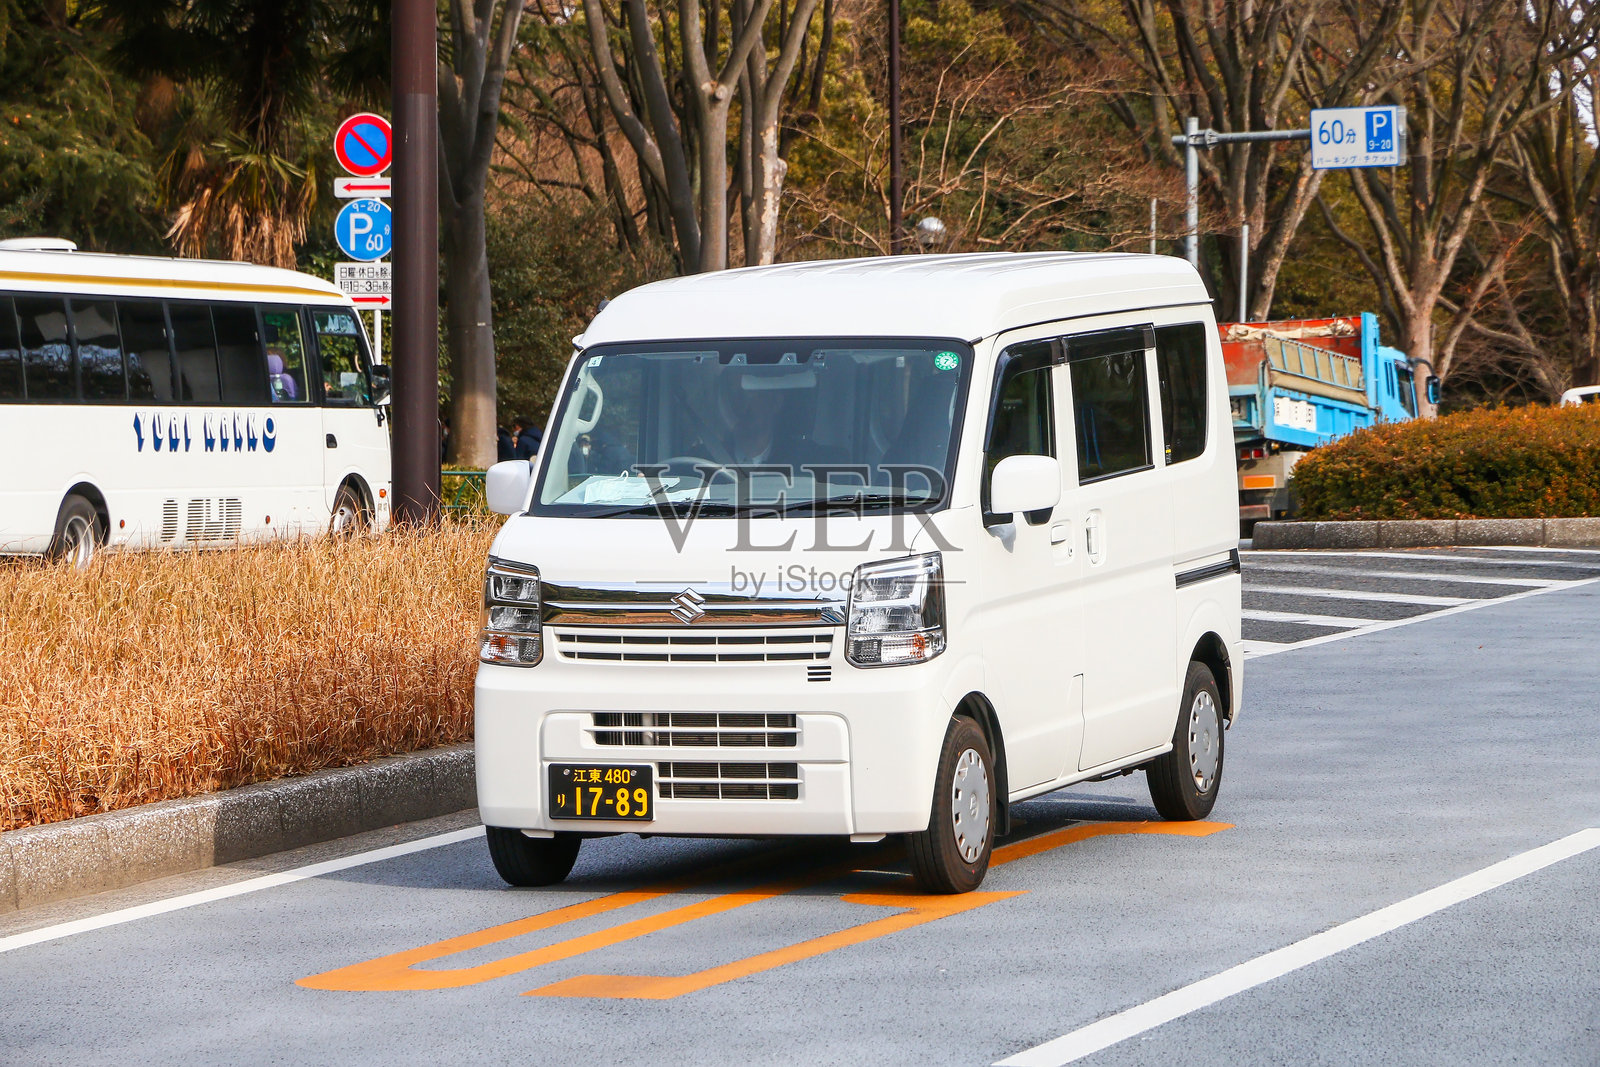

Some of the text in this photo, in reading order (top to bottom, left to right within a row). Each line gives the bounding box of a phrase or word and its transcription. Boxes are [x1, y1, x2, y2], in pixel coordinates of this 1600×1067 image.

[1373, 113, 1388, 138] P
[1368, 139, 1392, 150] 9-20
[352, 201, 381, 213] 9-20
[350, 213, 373, 251] P
[133, 411, 277, 453] YUAI KANKO
[573, 768, 631, 784] 江東 480
[557, 786, 648, 817] り 17-89
